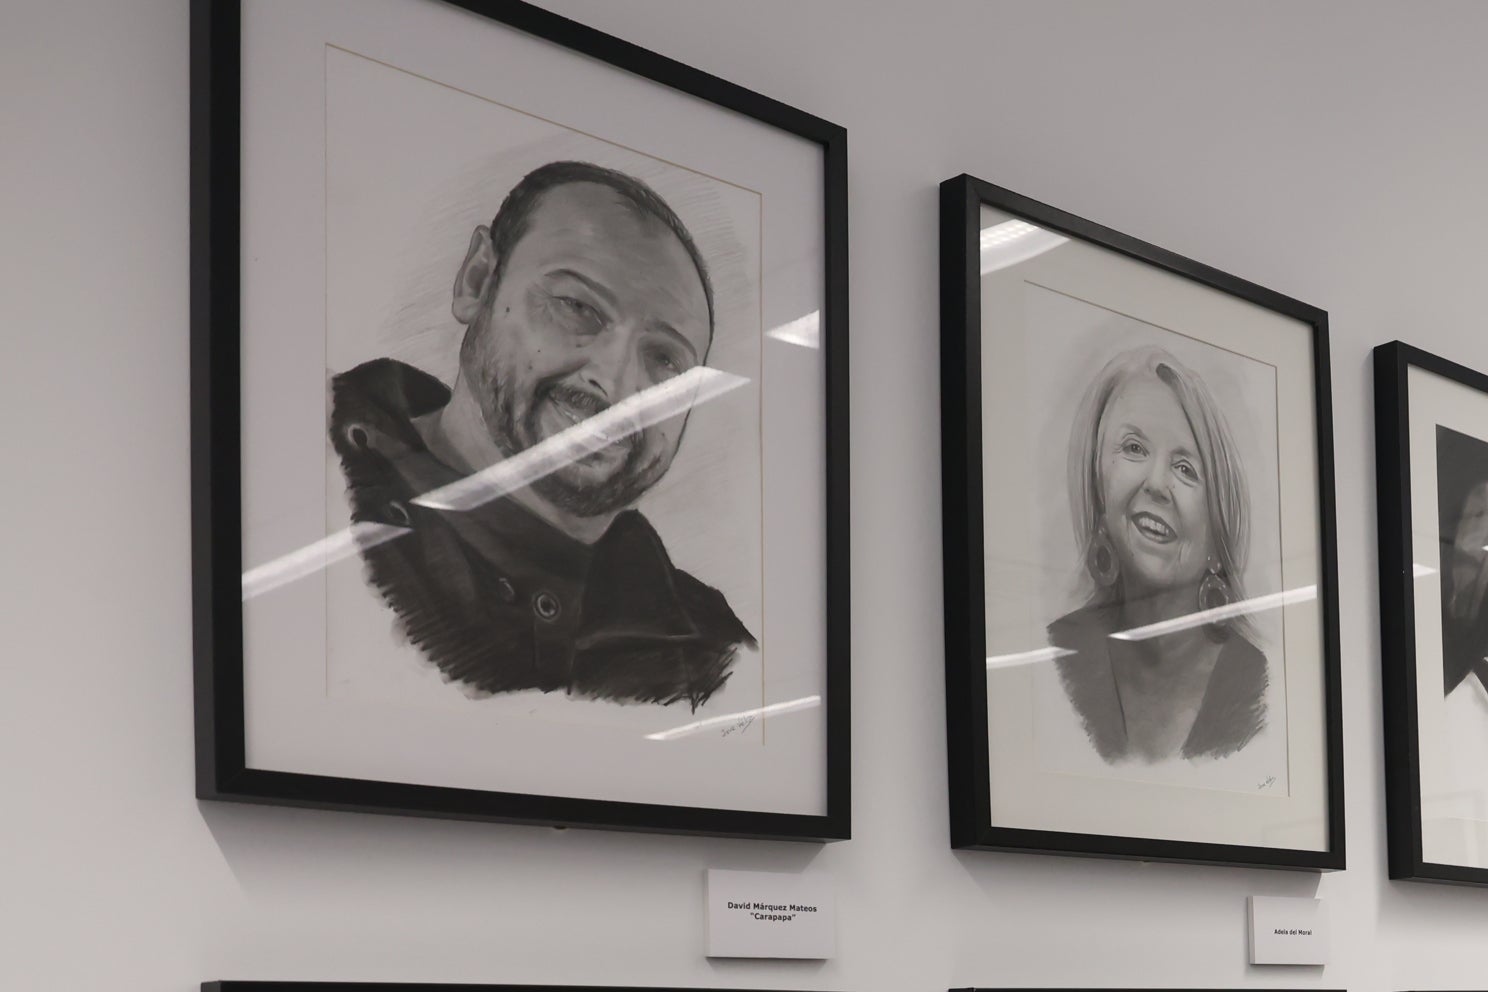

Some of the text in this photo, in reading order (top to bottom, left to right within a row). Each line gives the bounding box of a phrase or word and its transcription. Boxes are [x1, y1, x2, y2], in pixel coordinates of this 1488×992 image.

[727, 901, 817, 912] David Márquez Mateos
[750, 912, 796, 922] “Carapapa”
